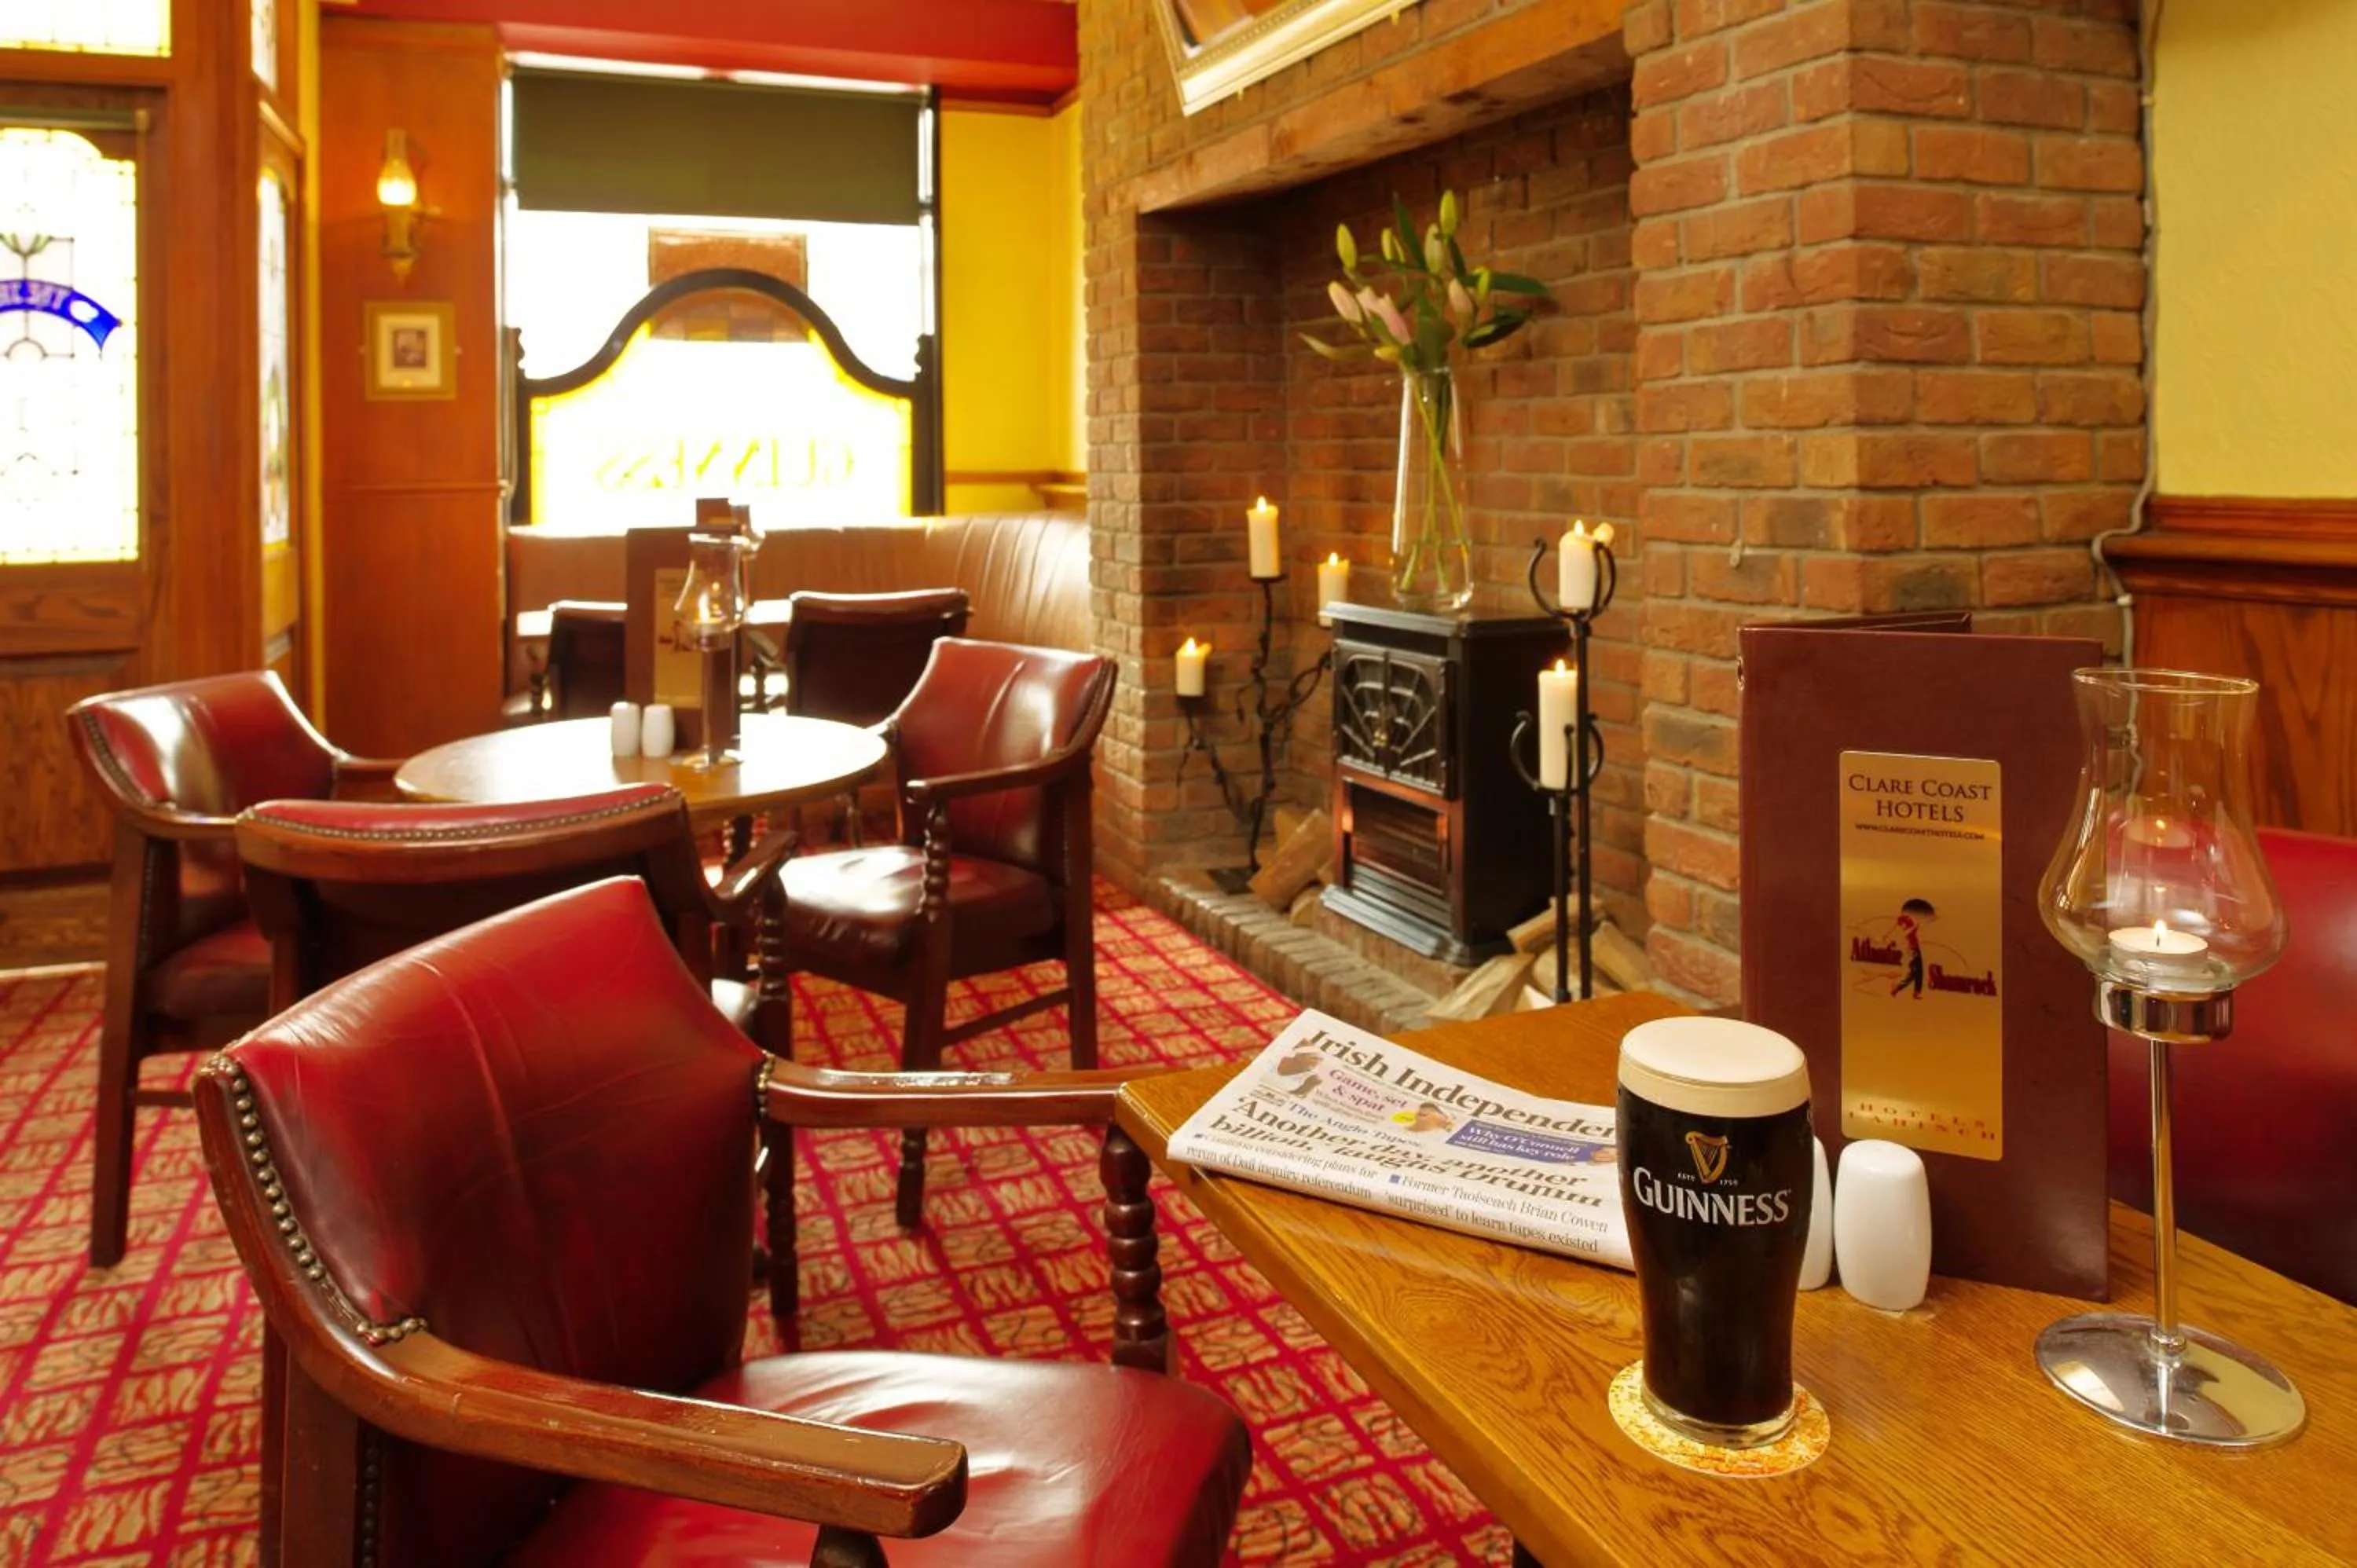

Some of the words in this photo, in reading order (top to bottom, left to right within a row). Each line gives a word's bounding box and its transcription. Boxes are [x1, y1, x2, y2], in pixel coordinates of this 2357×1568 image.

[1849, 773, 1913, 794] CLARE
[1922, 779, 1992, 800] COAST
[1876, 799, 1965, 822] HOTELS
[1310, 1030, 1389, 1078] Irish
[1332, 1085, 1345, 1097] &
[1349, 1094, 1386, 1112] spat
[1186, 1145, 1217, 1162] rerun
[1219, 1152, 1233, 1167] of
[1257, 1158, 1300, 1183] inquiry
[1302, 1171, 1373, 1200] referendum
[1255, 1144, 1323, 1168] considering
[1324, 1156, 1357, 1177] plans
[1358, 1163, 1379, 1179] for
[1334, 1146, 1447, 1173] laughs
[1457, 1171, 1603, 1207] Drumm
[1440, 1157, 1589, 1186] another
[1401, 1174, 1450, 1195] Former
[1519, 1200, 1558, 1222] Brian
[1560, 1210, 1609, 1233] Cowen
[1633, 1166, 1790, 1226] GUINNESS
[1455, 1208, 1470, 1222] to
[1471, 1211, 1506, 1233] learn
[1508, 1221, 1545, 1241] tapes
[1547, 1231, 1599, 1254] existed
